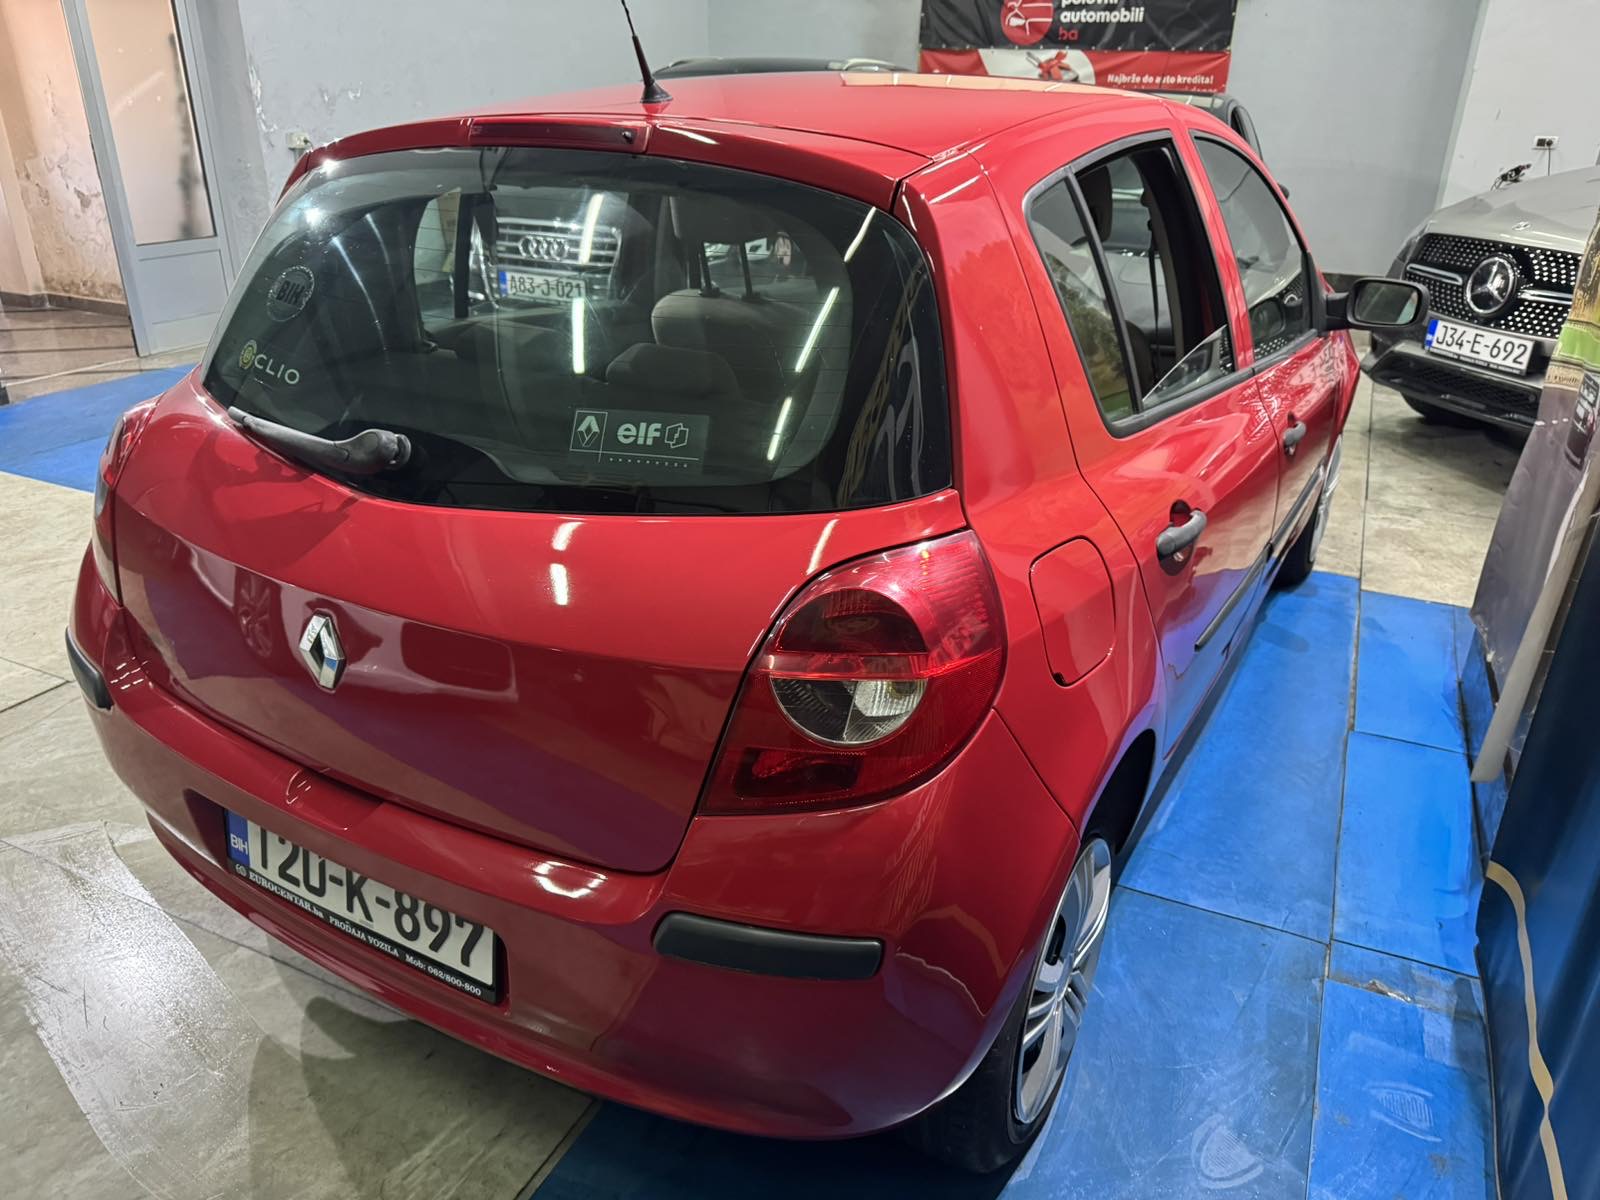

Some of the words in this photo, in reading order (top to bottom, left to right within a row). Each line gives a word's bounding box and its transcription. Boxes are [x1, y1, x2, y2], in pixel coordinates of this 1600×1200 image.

[1060, 7, 1145, 23] automobili
[1142, 74, 1154, 84] do
[1177, 74, 1214, 85] kredita!
[510, 275, 582, 298] A83-J-021
[1436, 325, 1528, 365] J34-E-692
[254, 354, 300, 384] CLIO
[617, 422, 662, 445] elf
[230, 833, 248, 855] BIH
[249, 871, 325, 919] EUROCENTAR.ba
[329, 916, 367, 941] PRODAJA
[367, 935, 400, 957] VOZILA
[405, 953, 426, 970] Mob:
[427, 965, 482, 996] 062/800-800
